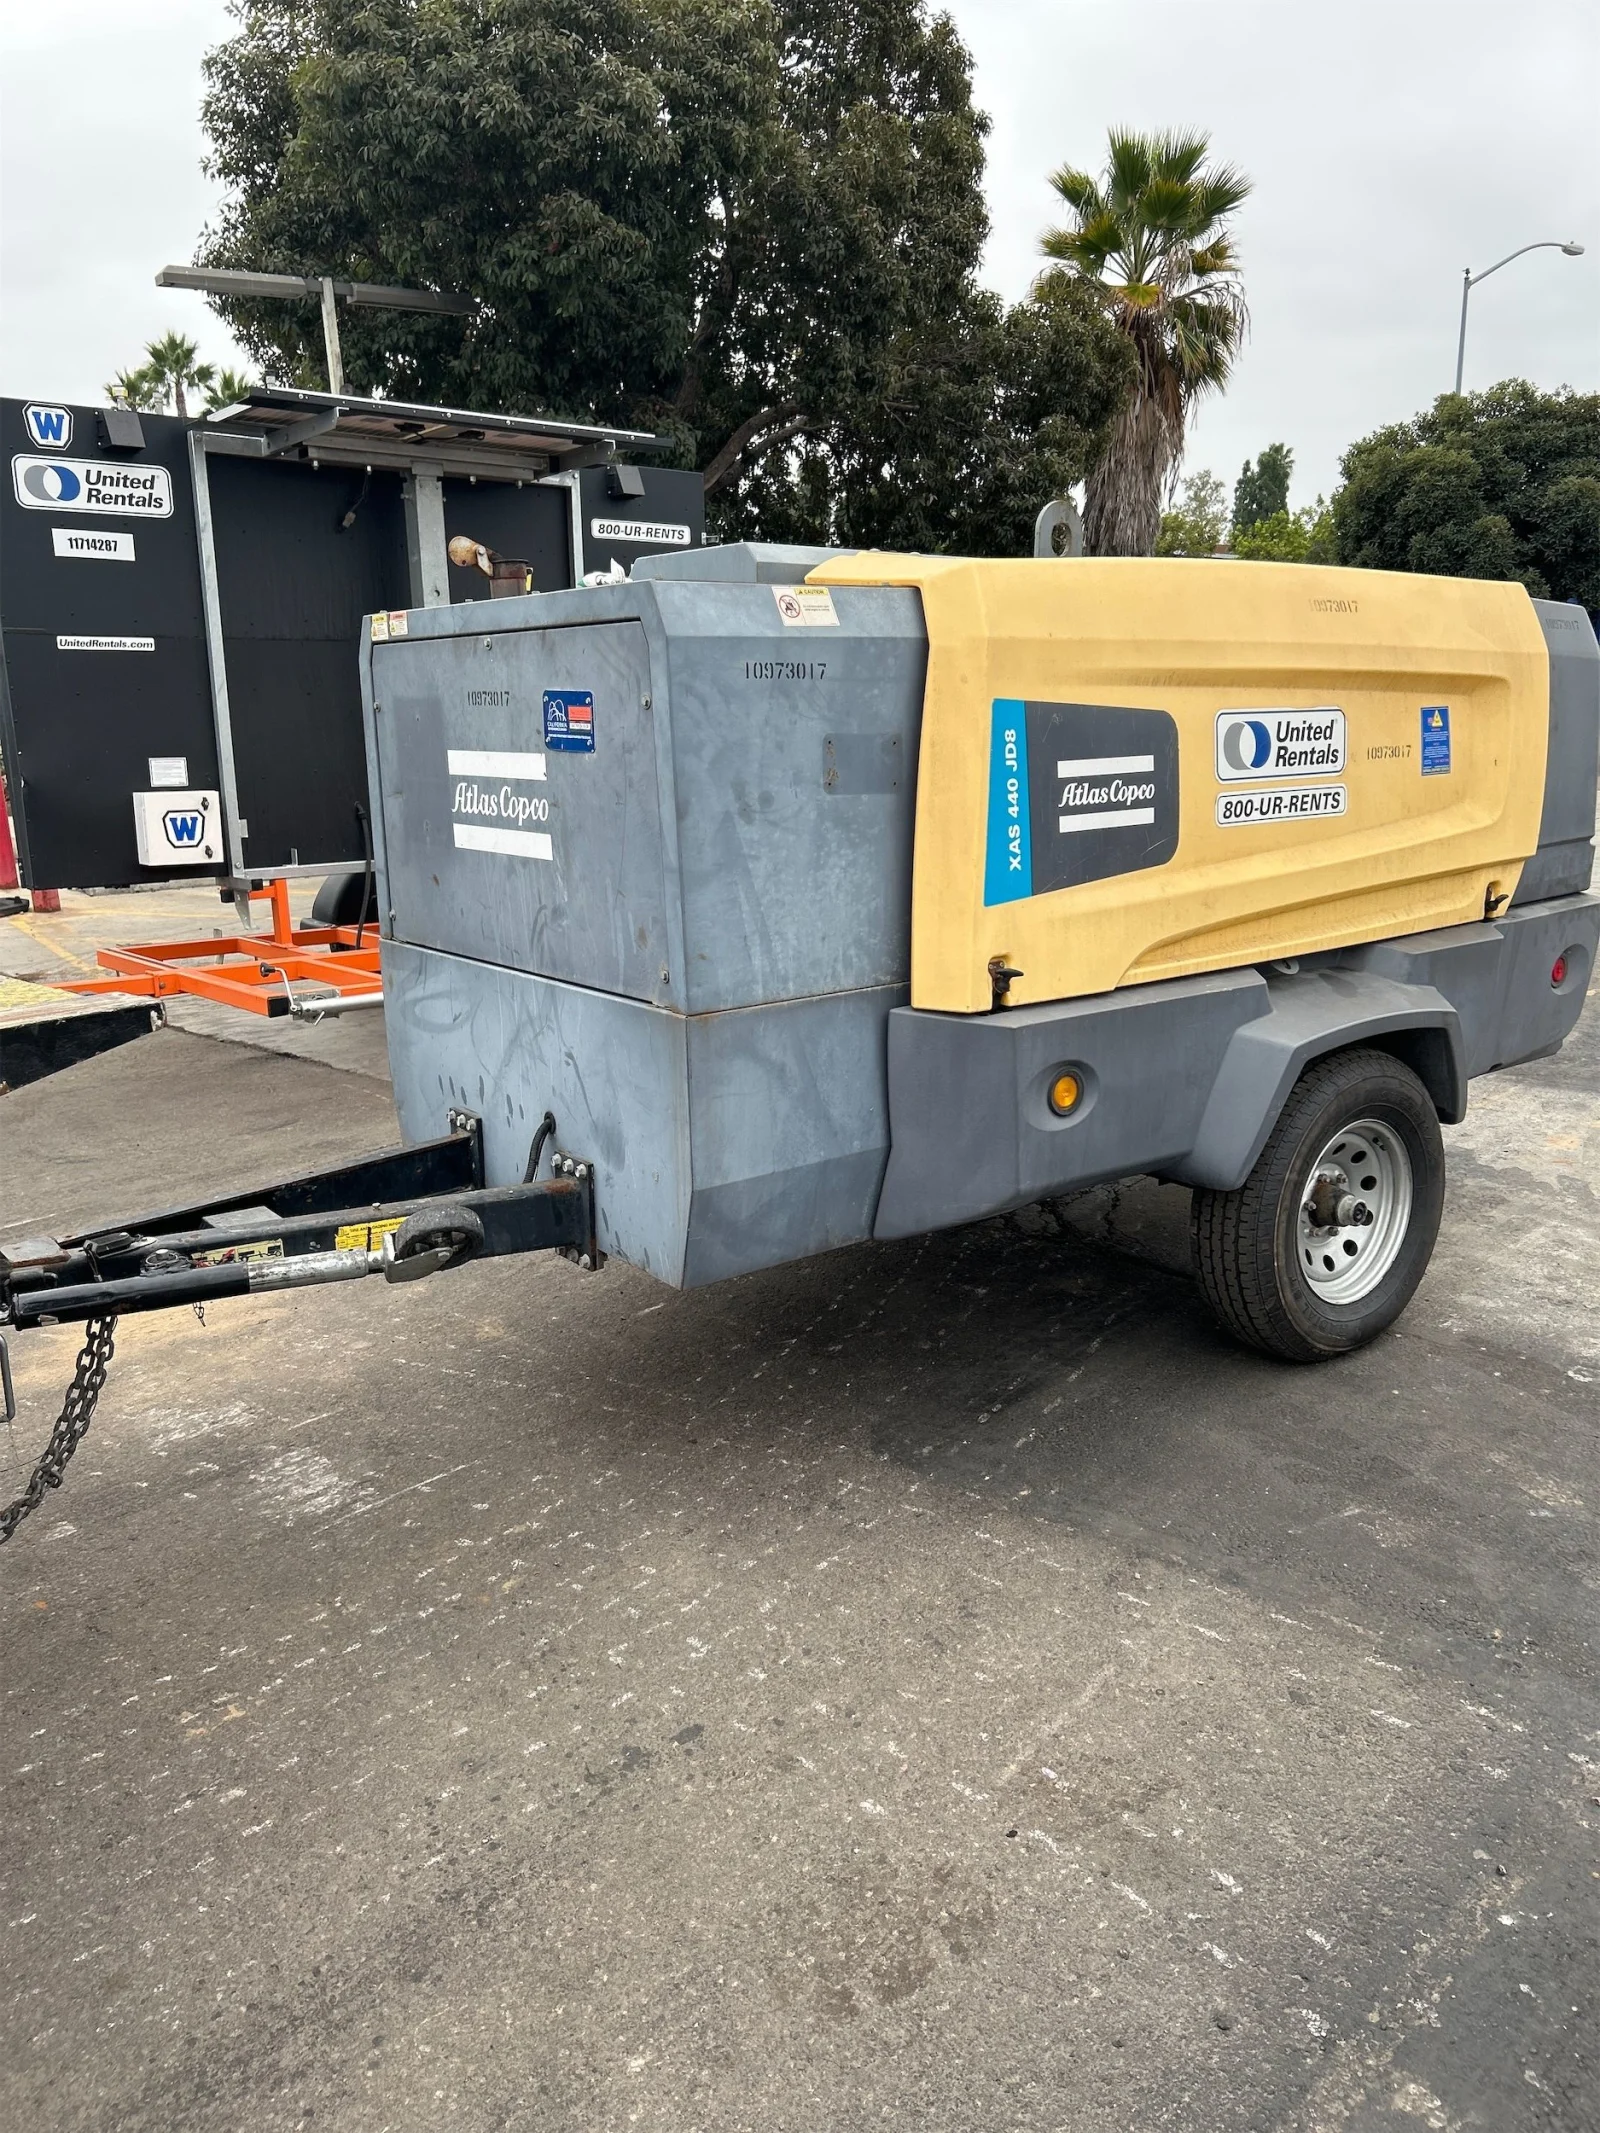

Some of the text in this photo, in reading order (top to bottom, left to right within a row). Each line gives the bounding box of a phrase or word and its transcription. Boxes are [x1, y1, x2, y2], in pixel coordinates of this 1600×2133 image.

[85, 469, 156, 490] United
[86, 487, 164, 509] Rentals
[598, 523, 685, 540] 800-UR-RENTS
[67, 537, 118, 552] 11714287
[59, 638, 153, 650] UnitedRentals.com
[745, 661, 827, 680] 10973017
[467, 690, 510, 707] 10973017
[1276, 718, 1335, 743] United
[1275, 743, 1339, 767] Rentals
[1367, 744, 1412, 760] 10973017
[1004, 728, 1022, 872] XAS 440 JD8
[1058, 779, 1156, 807] Atlas Copco
[451, 782, 549, 827] Atlas Copco
[1223, 791, 1340, 819] 800-UR-RENTS
